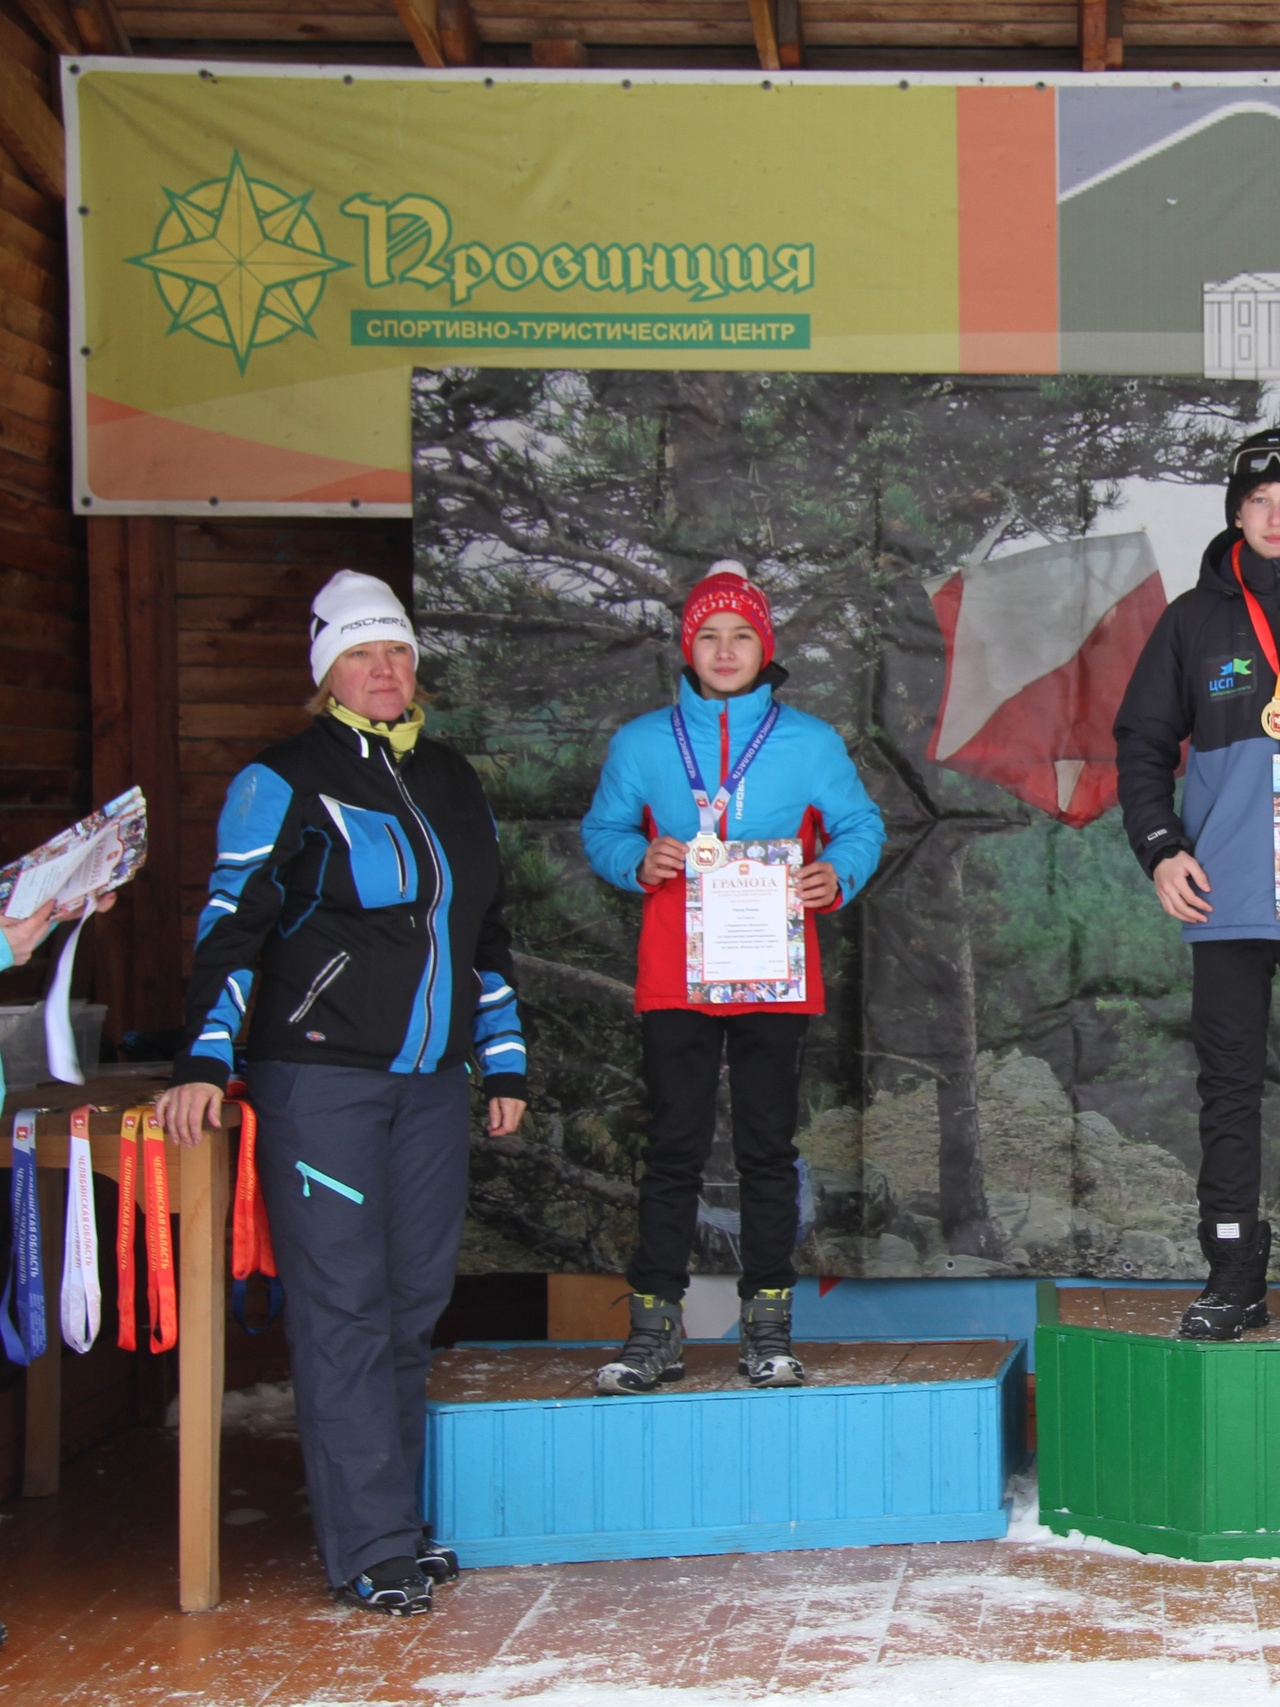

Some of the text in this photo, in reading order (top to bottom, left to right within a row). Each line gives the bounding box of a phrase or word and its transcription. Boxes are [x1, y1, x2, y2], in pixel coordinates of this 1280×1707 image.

[340, 193, 815, 306] Провинция
[366, 318, 796, 345] СПОРТИВНО-ТУРИСТИЧЕСКИЙ ЦЕНТР
[340, 617, 400, 635] FISCHER
[1208, 676, 1234, 692] ЦСП
[731, 748, 755, 780] ОБЛАСТЬ
[734, 777, 746, 820] RDSKI
[711, 876, 777, 889] ГРАМОТА
[78, 1155, 90, 1223] ЧЕЛЯБИНСКАЯ
[120, 1156, 133, 1270] ЧЕЛЯБИНСКАЯ ОБЛАСТЬ
[153, 1156, 170, 1270] ЧЕЛЯБИНСКАЯ ОБЛАСТЬ
[29, 1234, 39, 1278] ОБЛАСТЬ
[83, 1224, 94, 1267] ОБЛАСТЬ
